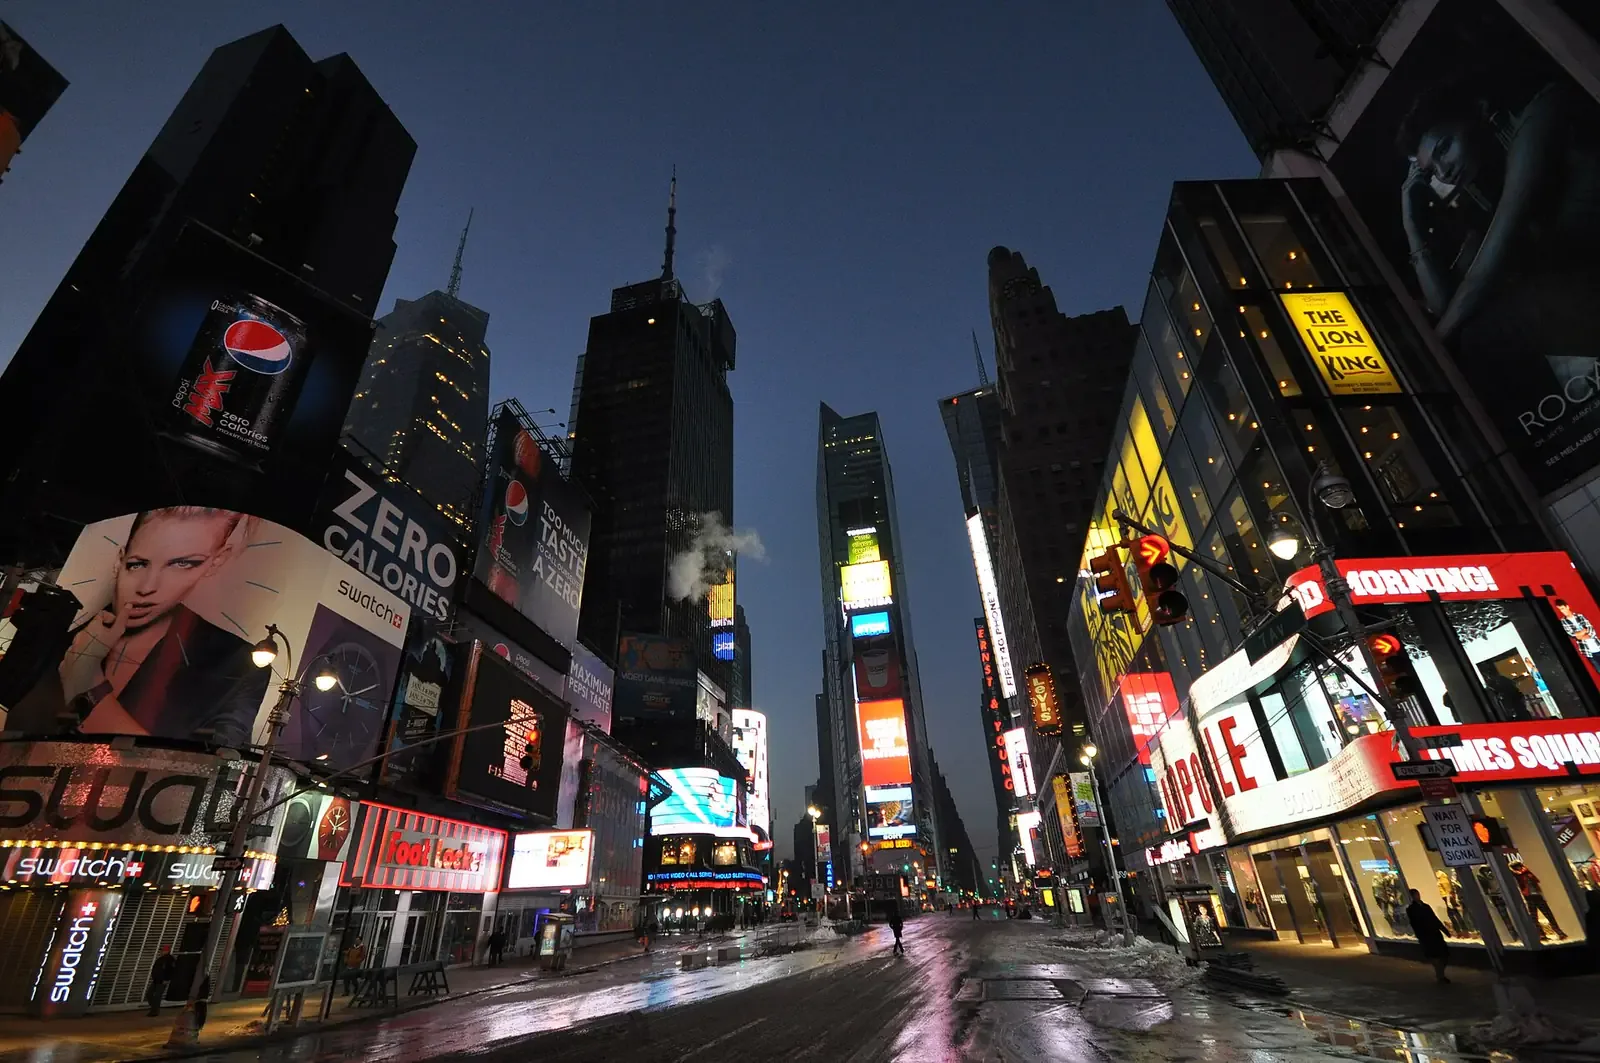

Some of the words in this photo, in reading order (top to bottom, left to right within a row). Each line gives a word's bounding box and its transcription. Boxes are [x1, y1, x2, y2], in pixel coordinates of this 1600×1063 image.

[1303, 310, 1346, 323] THE
[1306, 329, 1365, 352] LION
[1320, 356, 1382, 380] KING
[172, 378, 191, 409] pepsi
[183, 355, 238, 428] MAX
[219, 419, 269, 443] calories
[222, 411, 250, 426] zero
[332, 468, 457, 588] ZERO
[543, 500, 563, 530] TOO
[562, 523, 588, 558] MUCH
[540, 515, 587, 581] TASTE
[323, 525, 450, 621] CALORIES
[532, 555, 544, 579] A
[545, 564, 580, 611] ZERO
[338, 579, 394, 625] swatch
[987, 591, 1005, 637] PHONE?
[977, 628, 995, 688] ERNST
[1001, 650, 1015, 688] FIRST
[568, 677, 588, 700] PEPSI
[589, 690, 610, 714] TASTE
[570, 662, 611, 701] MAXIMUM
[990, 697, 999, 709] &
[994, 720, 1015, 791] YOUNG
[1400, 766, 1419, 775] ONE
[1428, 763, 1446, 774] WAY
[1432, 810, 1459, 822] WAIT
[1441, 824, 1463, 835] FOR
[386, 831, 431, 867] Foot
[1441, 836, 1474, 848] WALK
[1445, 849, 1480, 861] SIGNAL
[17, 855, 125, 879] swatch
[50, 916, 94, 1002] swatch
